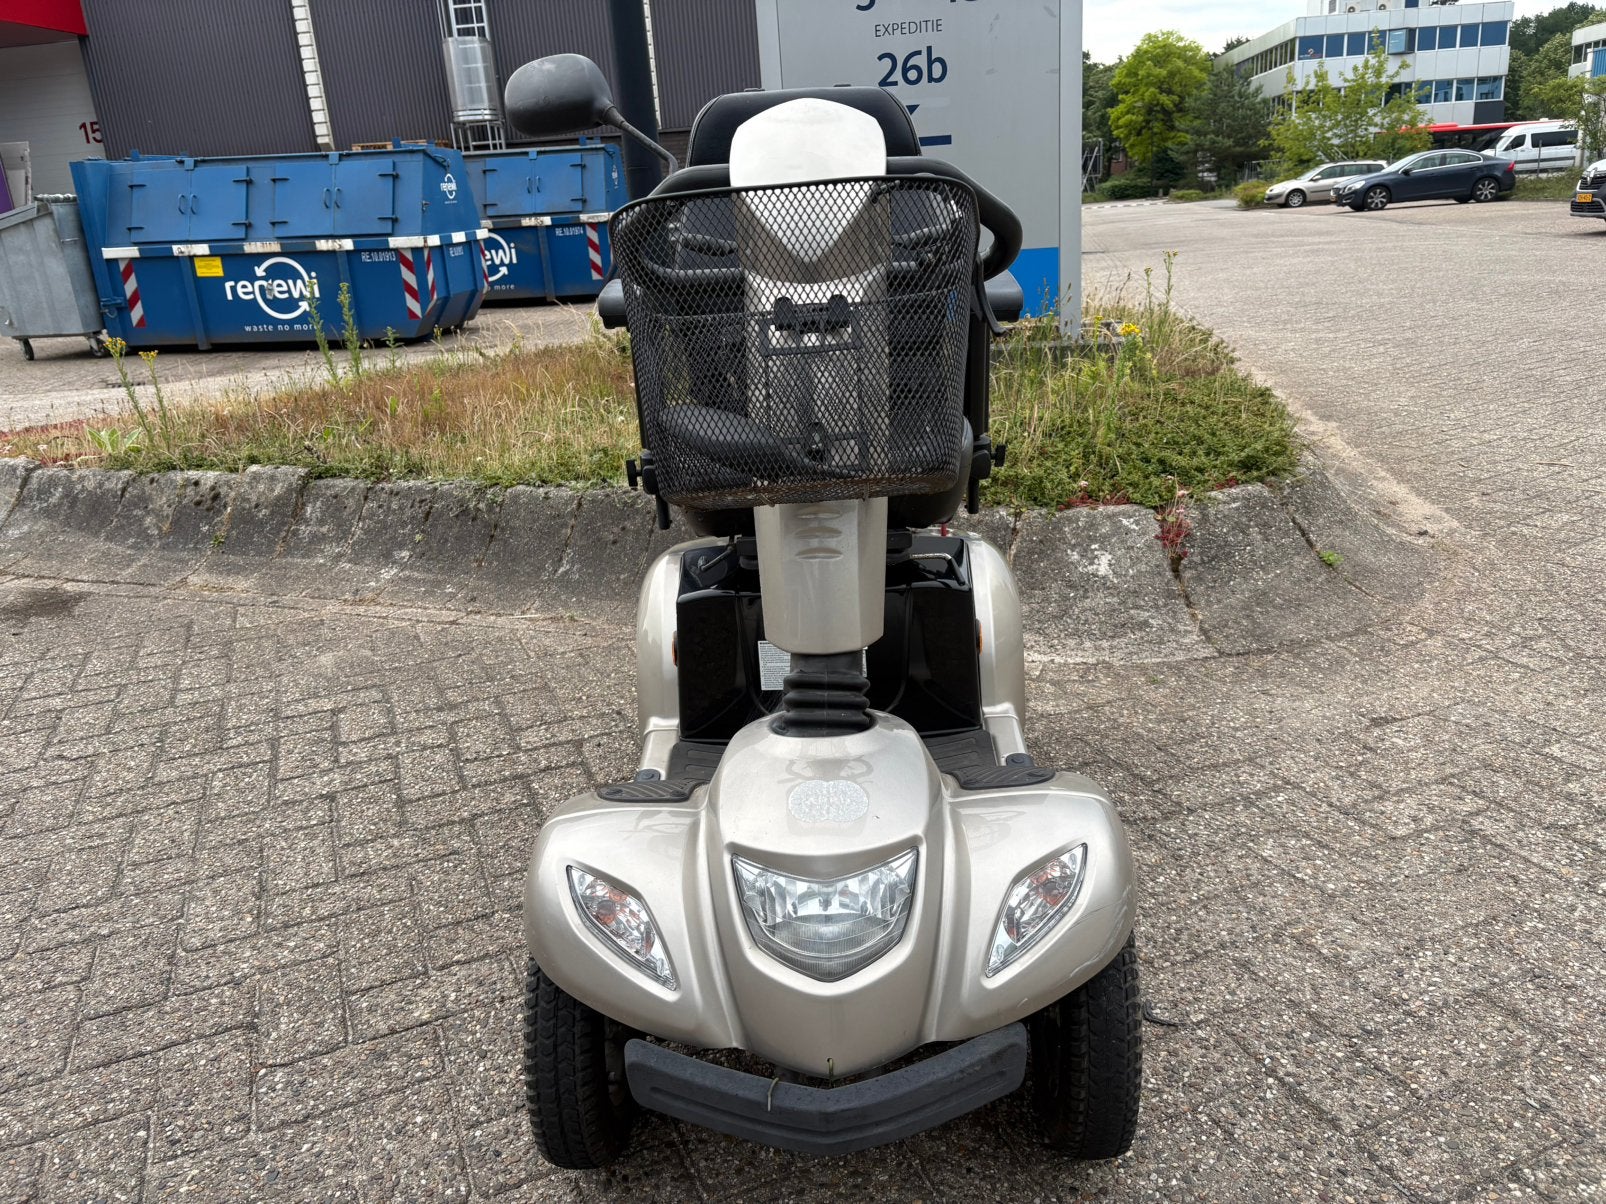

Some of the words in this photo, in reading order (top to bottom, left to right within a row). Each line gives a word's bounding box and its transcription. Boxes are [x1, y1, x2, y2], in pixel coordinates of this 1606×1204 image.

[874, 18, 943, 37] EXPEDITIE
[877, 45, 948, 87] 26b
[79, 121, 103, 144] 15
[224, 271, 320, 300] renewi
[244, 324, 274, 332] waste
